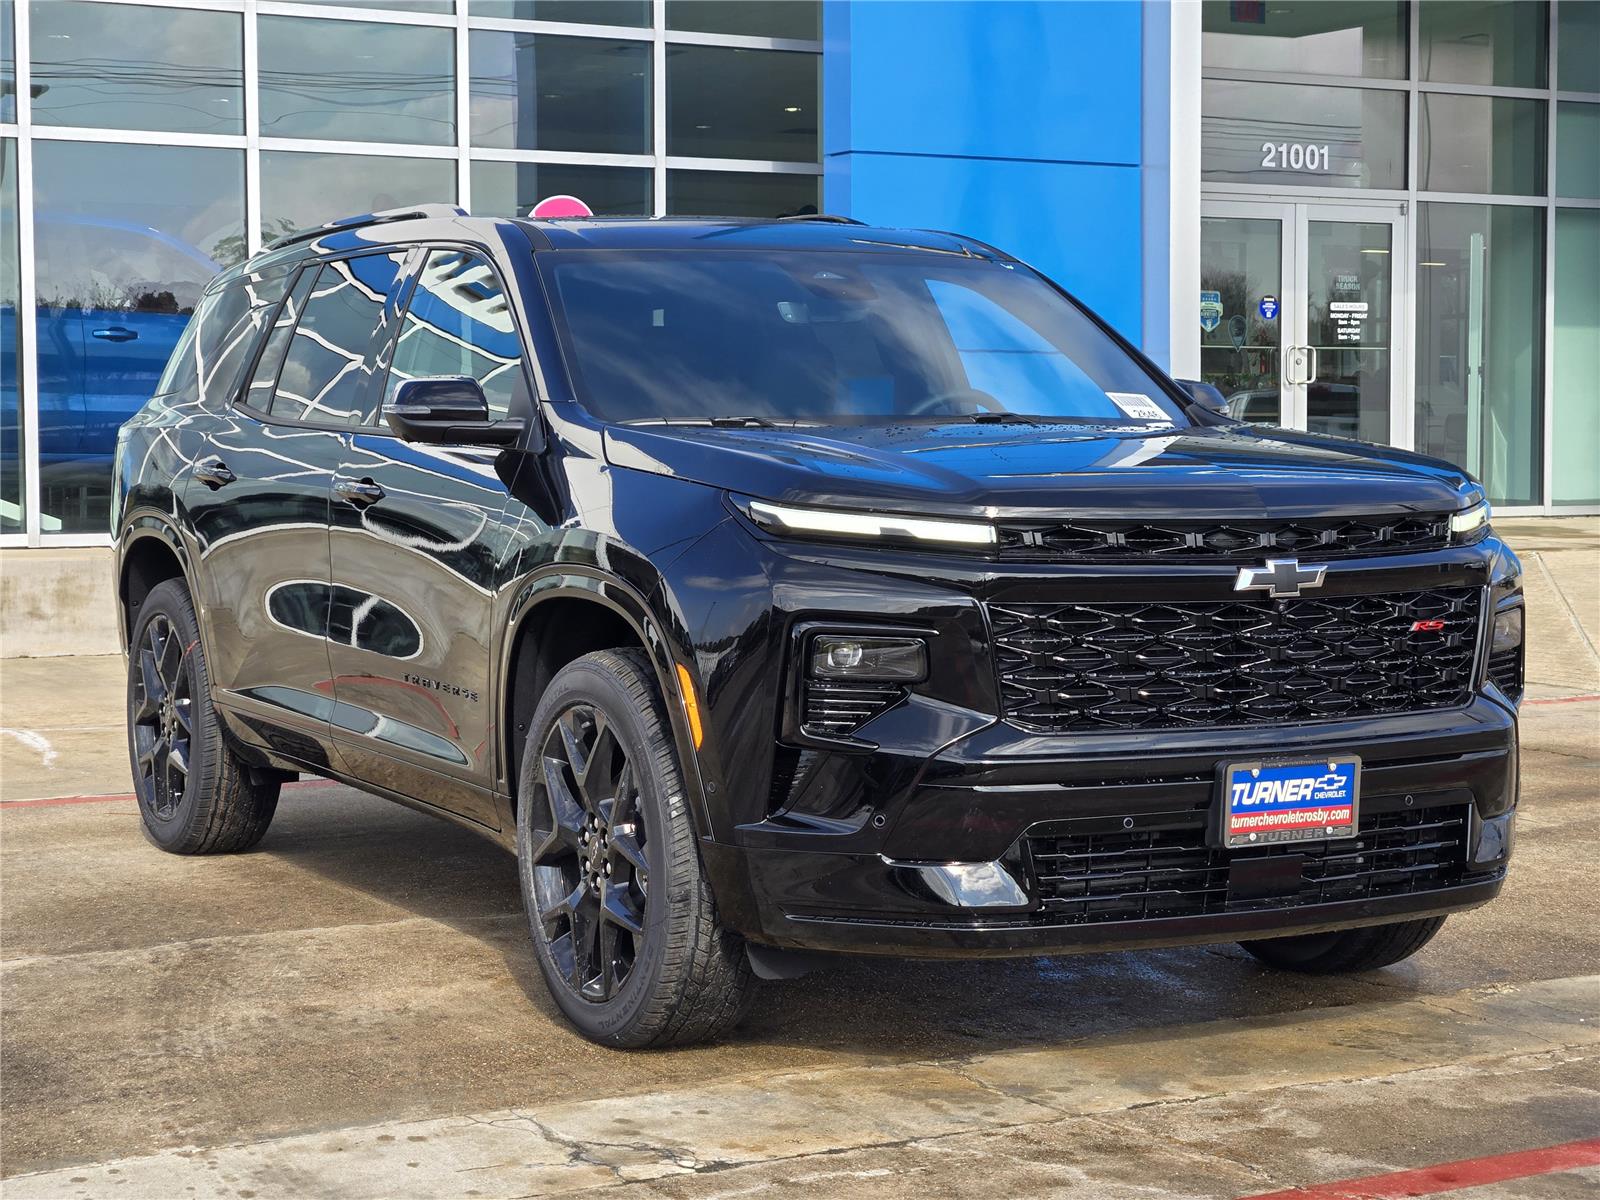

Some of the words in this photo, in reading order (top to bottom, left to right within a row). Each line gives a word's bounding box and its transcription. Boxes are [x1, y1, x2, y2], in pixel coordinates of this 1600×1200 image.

[1261, 142, 1329, 170] 21001
[1335, 282, 1361, 291] SEASON
[1409, 620, 1444, 631] RS
[403, 673, 478, 702] TRAVERSE
[1231, 778, 1315, 806] TURNER
[1314, 790, 1346, 799] CHEVROLET
[1231, 808, 1350, 829] turnerchevroletcrosby.com
[1257, 828, 1325, 842] TURNER
